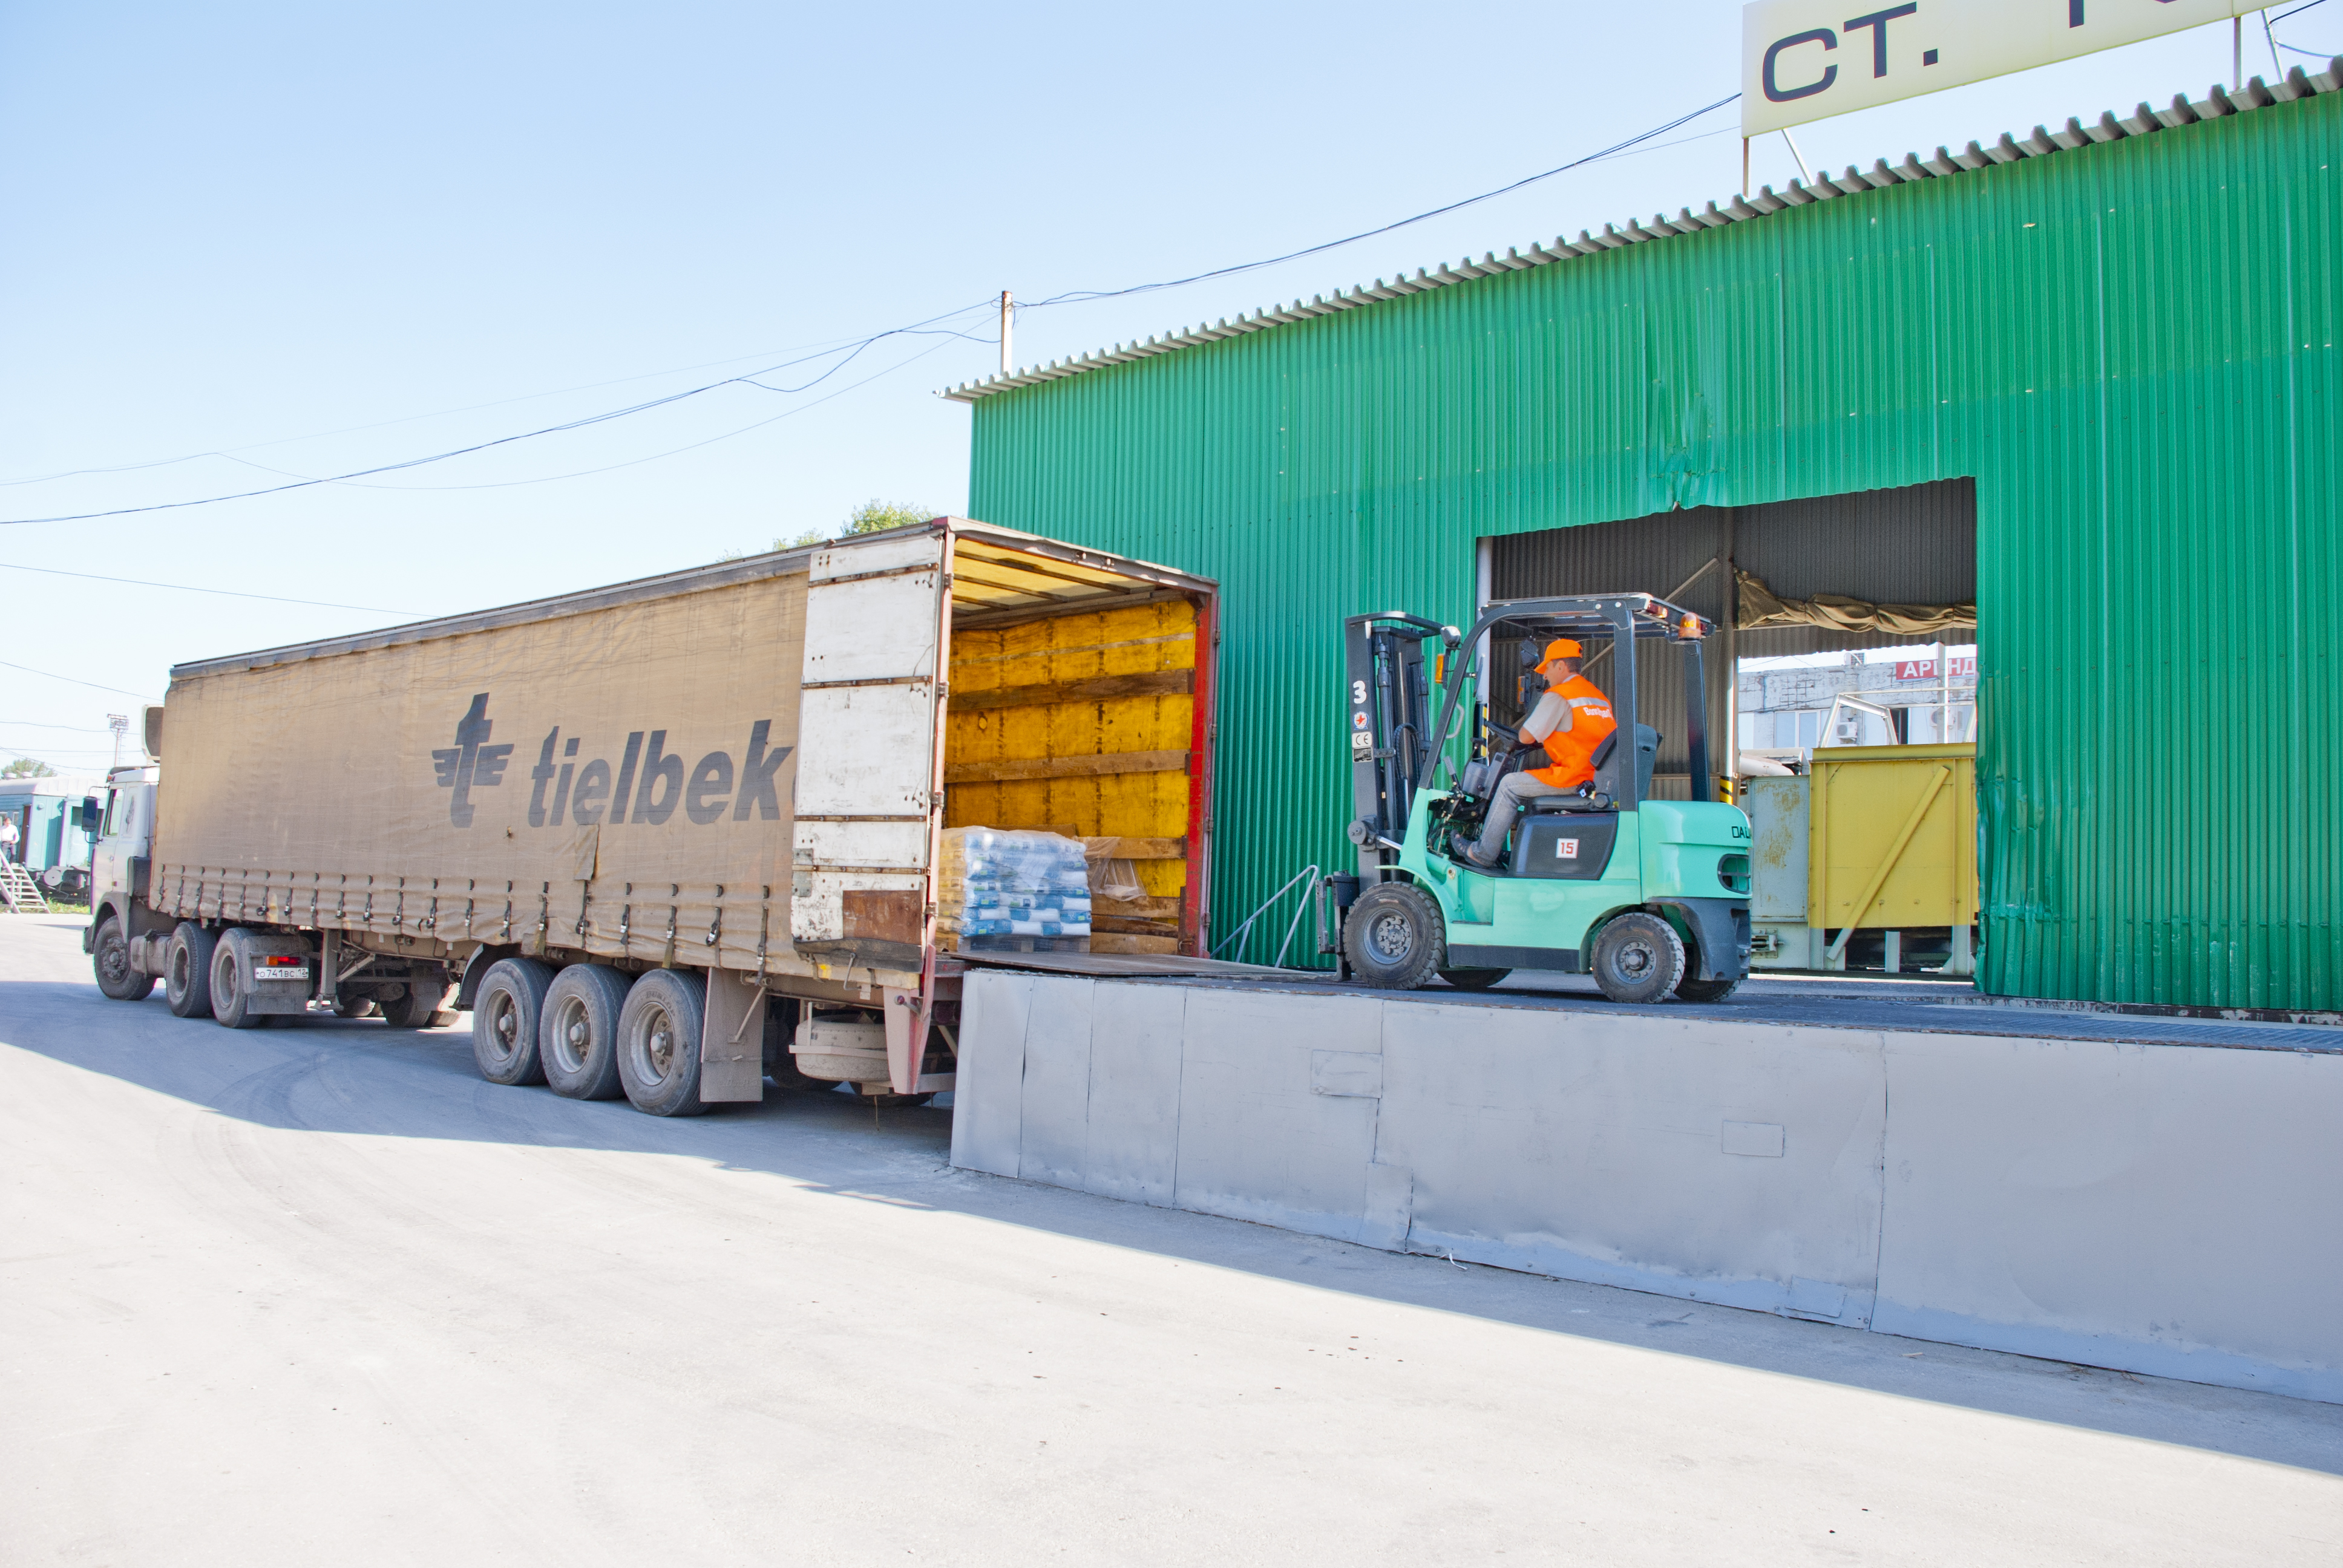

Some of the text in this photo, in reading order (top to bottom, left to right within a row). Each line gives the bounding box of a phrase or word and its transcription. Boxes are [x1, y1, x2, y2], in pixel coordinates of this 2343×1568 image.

[1903, 658, 1976, 678] АРНД
[1353, 680, 1367, 704] 3
[528, 719, 796, 828] tielbek
[1561, 843, 1574, 854] 15
